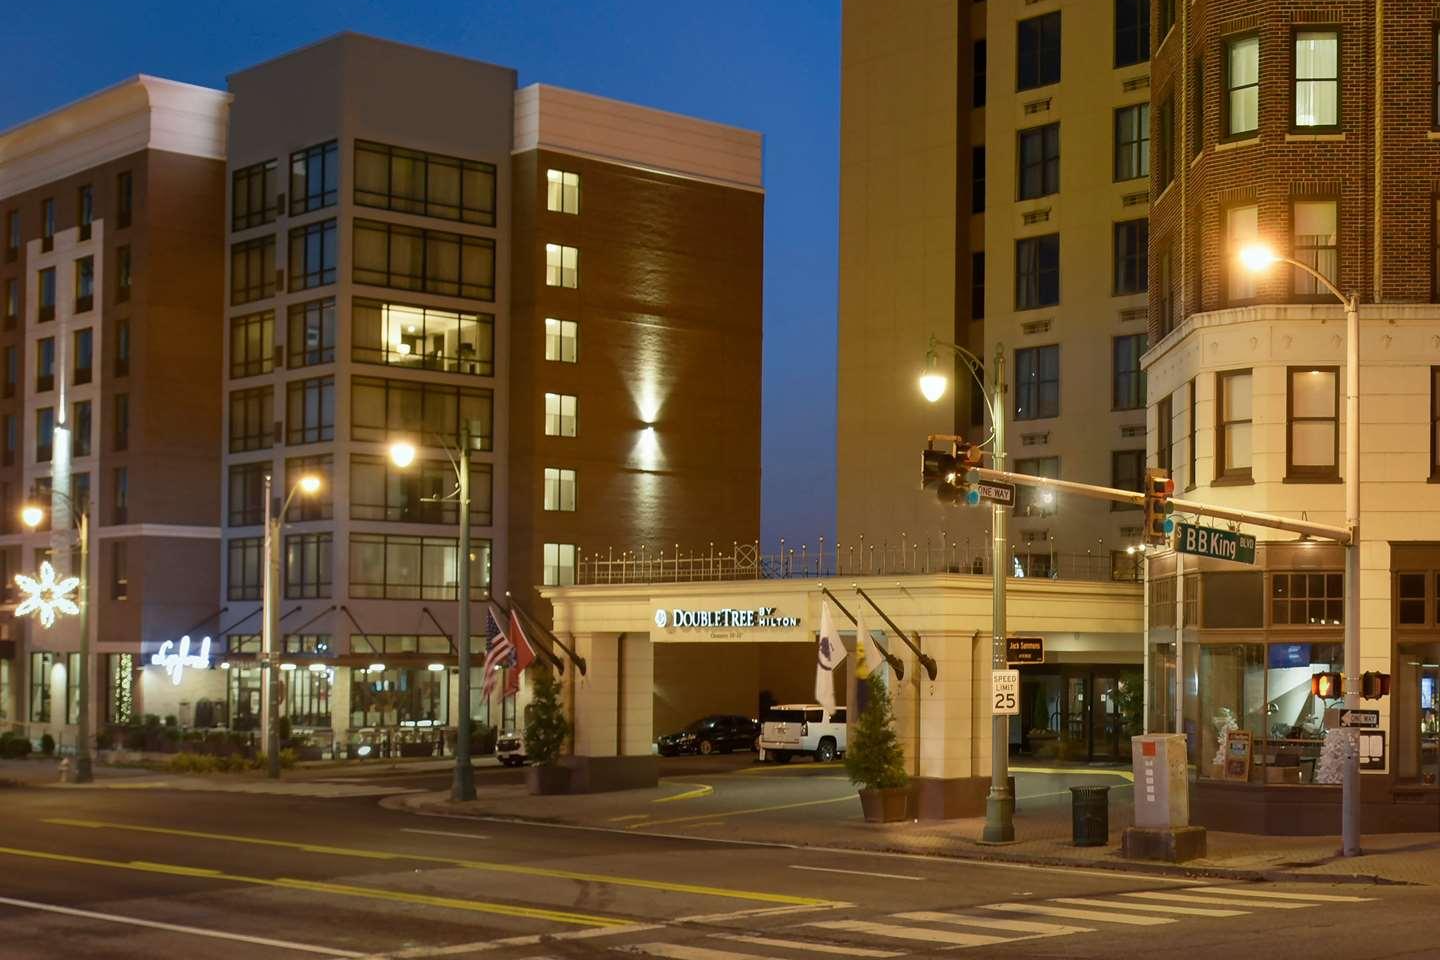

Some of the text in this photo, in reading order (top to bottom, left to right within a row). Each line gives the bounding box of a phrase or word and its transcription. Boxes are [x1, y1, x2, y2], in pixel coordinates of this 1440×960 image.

[994, 488, 1008, 498] WAY
[1177, 526, 1182, 538] S
[1210, 532, 1236, 559] King
[1239, 537, 1254, 549] BLVD
[759, 607, 773, 616] BY
[759, 617, 797, 627] HILTON
[995, 693, 1016, 708] 25
[1363, 714, 1376, 722] WAY
